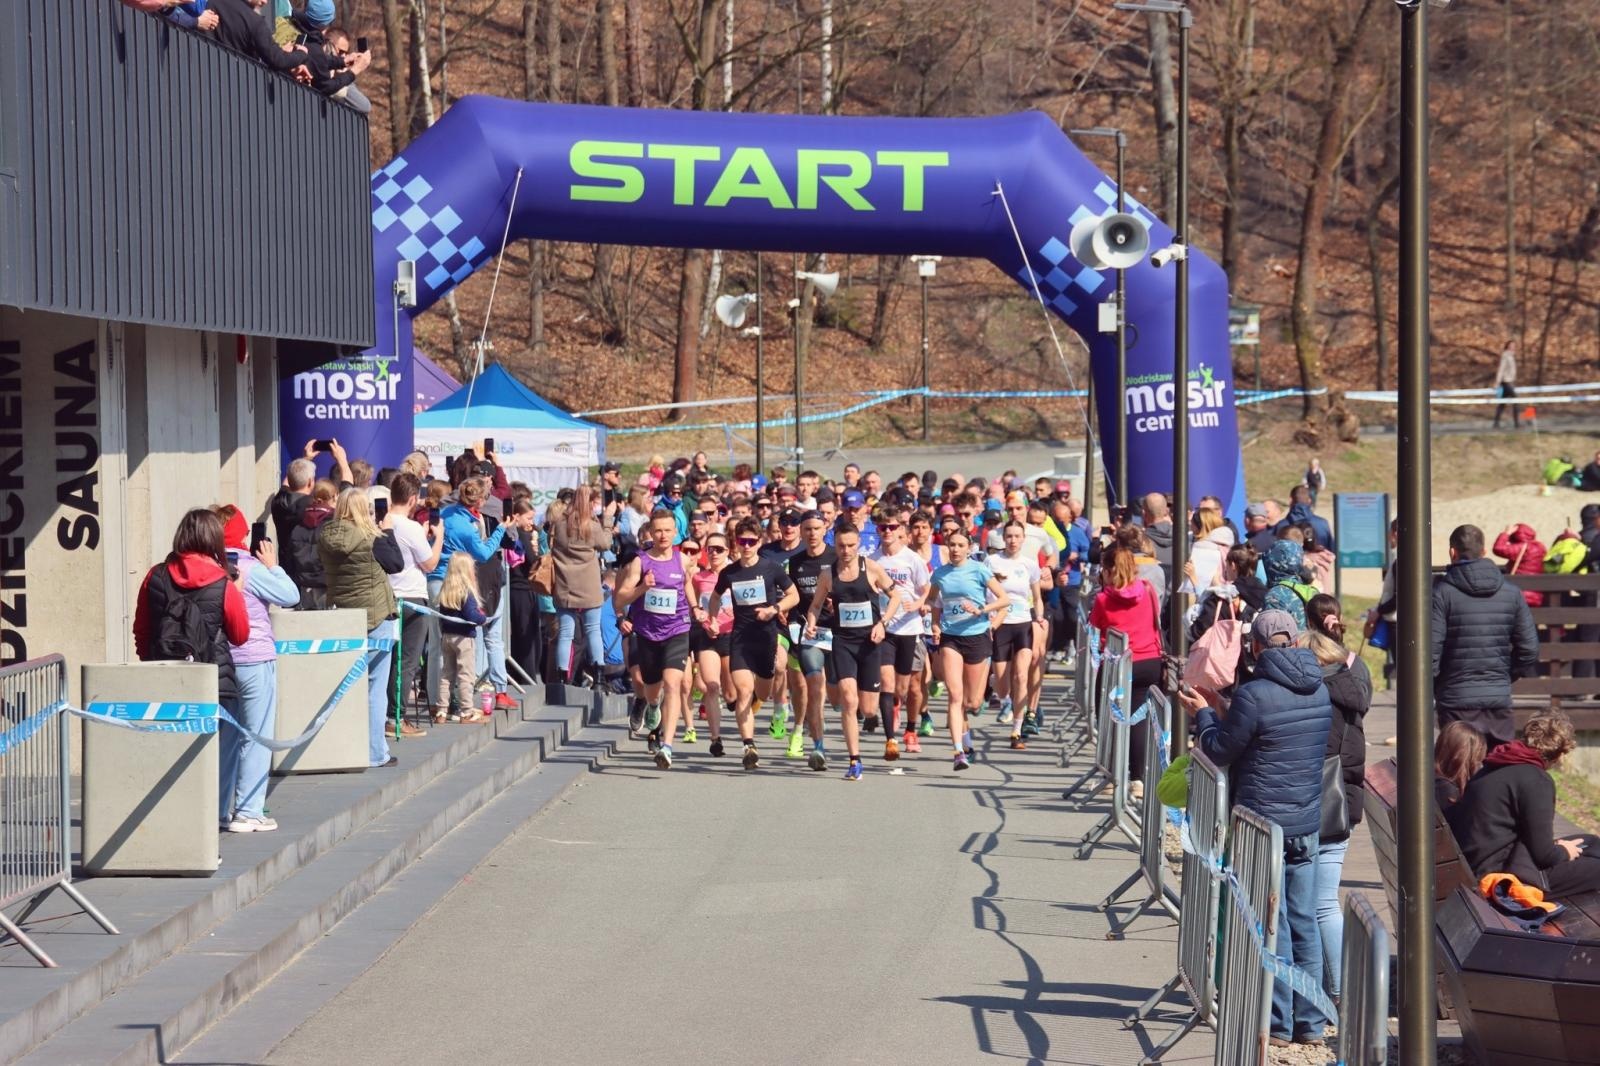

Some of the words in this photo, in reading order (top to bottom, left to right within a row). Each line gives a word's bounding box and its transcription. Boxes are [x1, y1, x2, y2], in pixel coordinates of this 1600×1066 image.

[569, 140, 949, 212] START
[294, 371, 401, 400] mosir
[305, 401, 389, 420] centrum
[53, 339, 100, 550] SAUNA
[650, 595, 671, 607] 311
[742, 588, 756, 599] 62
[845, 609, 866, 621] 271
